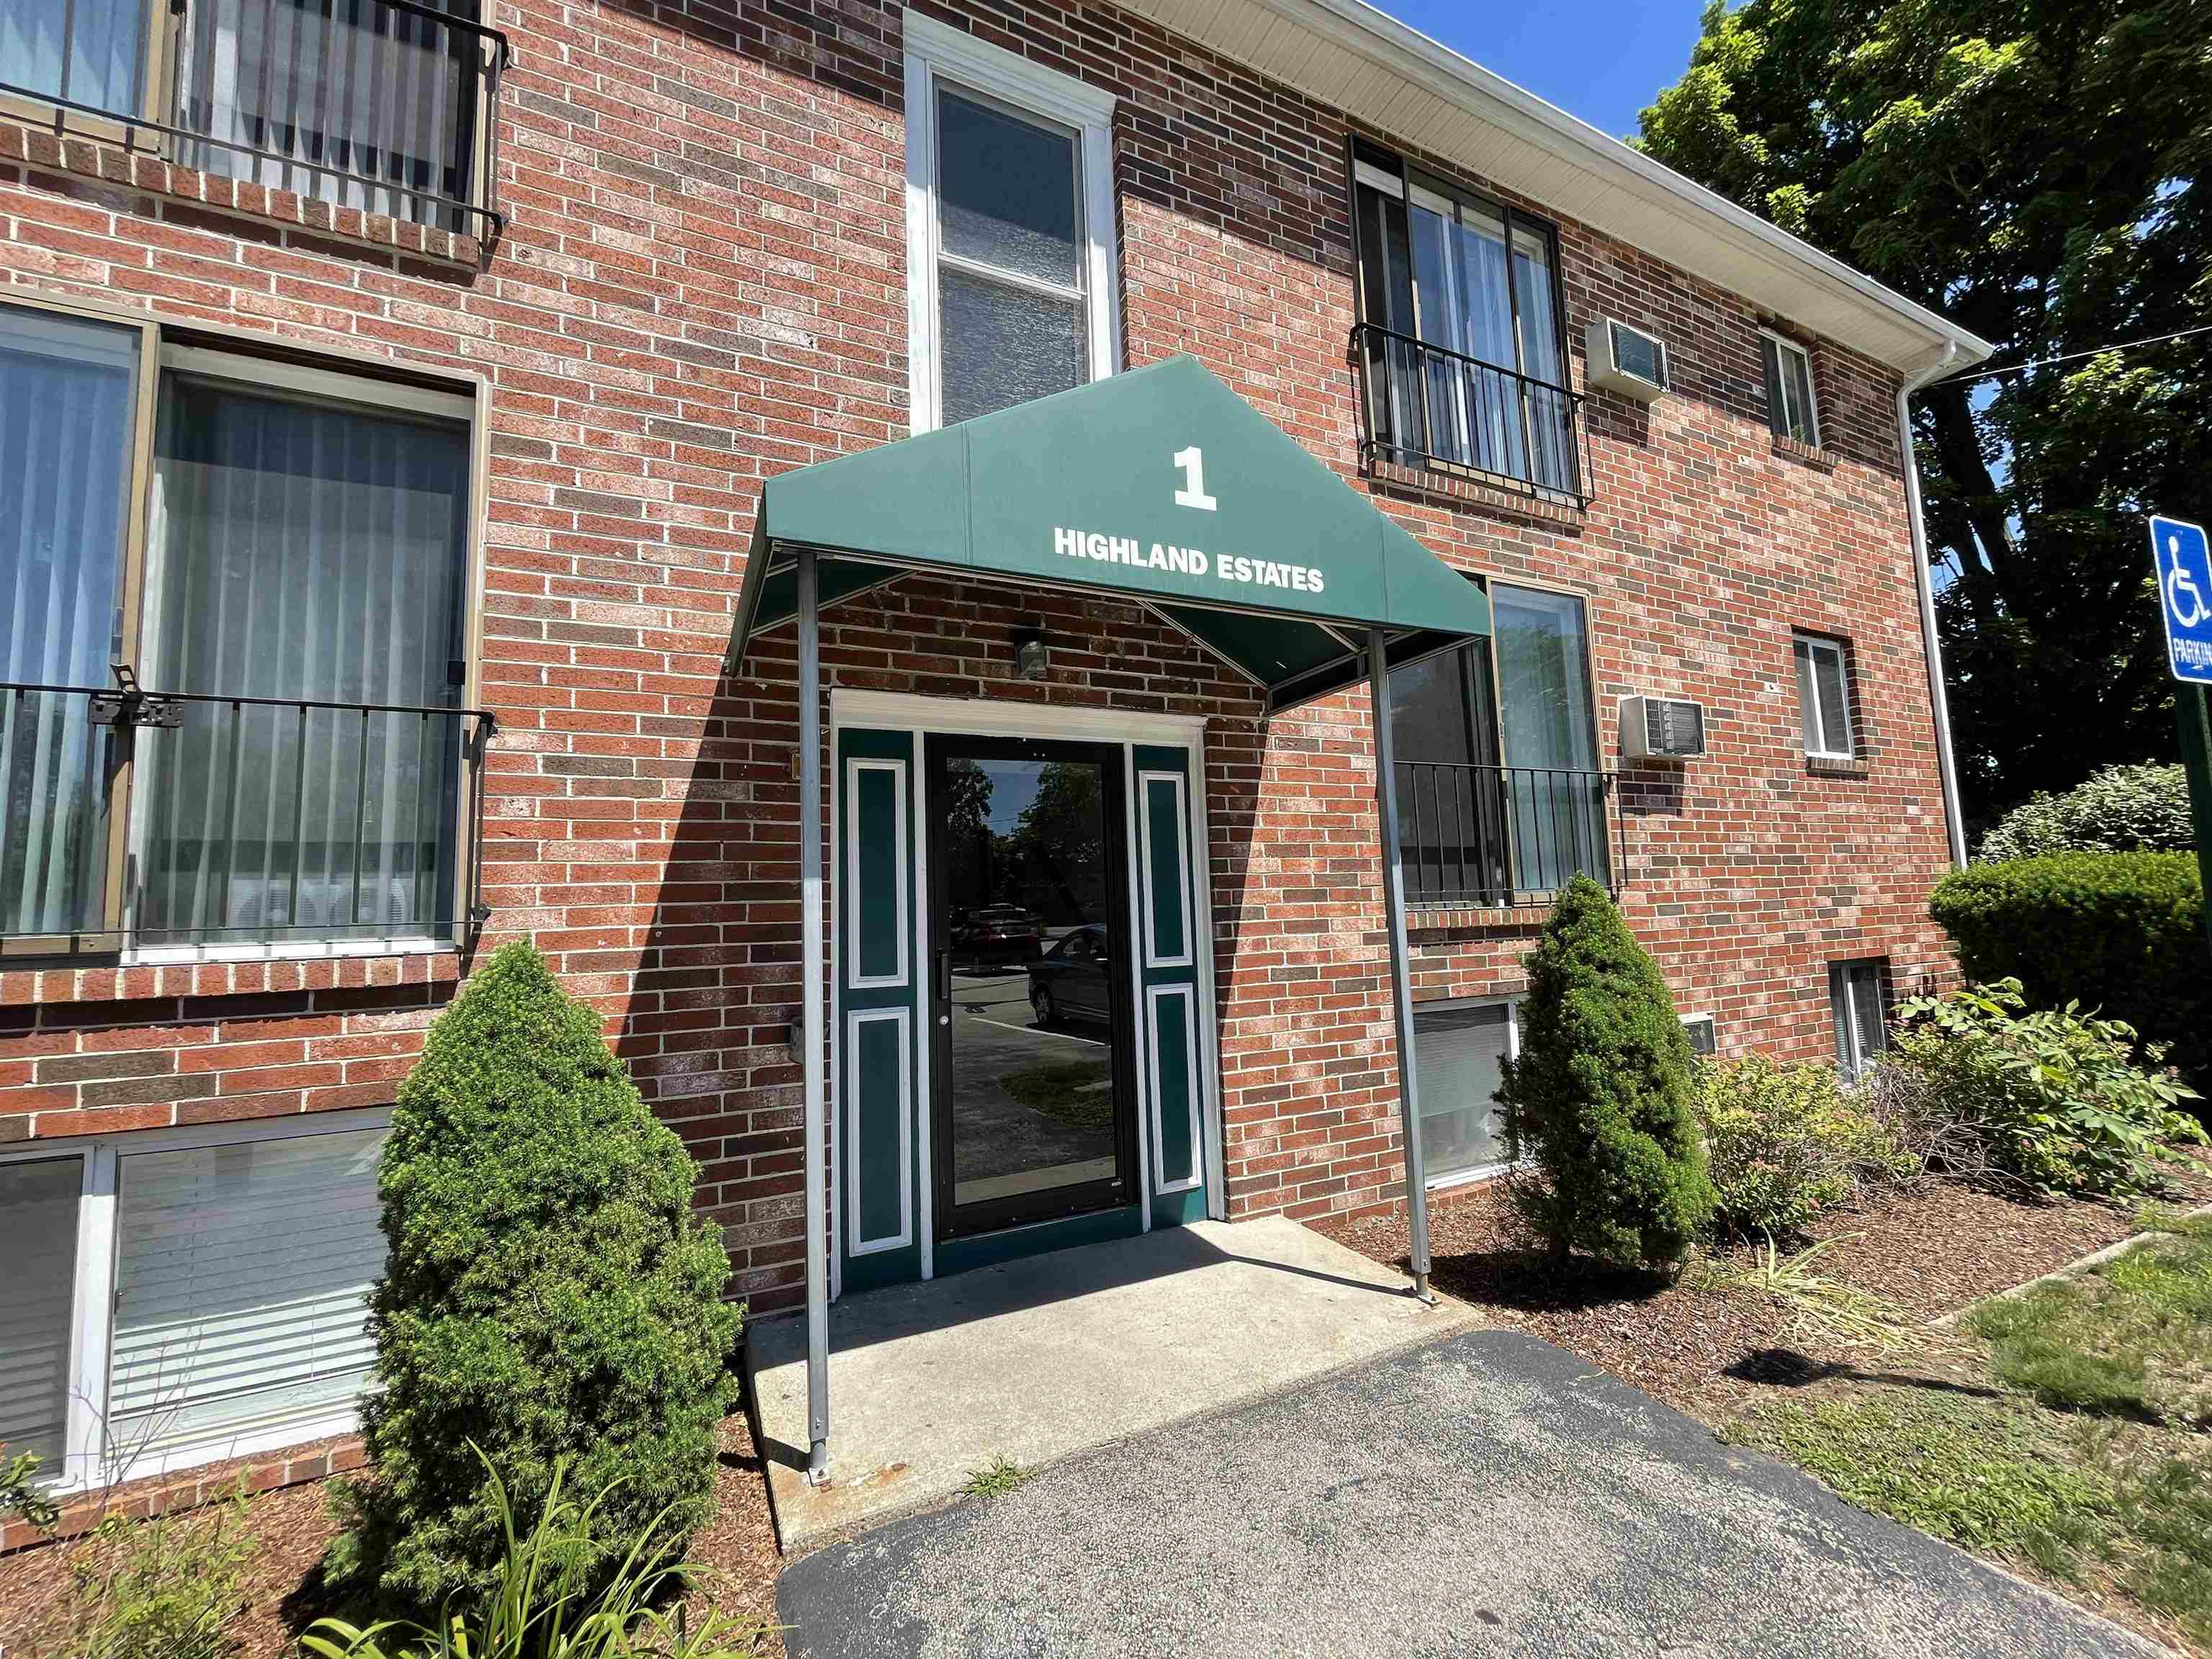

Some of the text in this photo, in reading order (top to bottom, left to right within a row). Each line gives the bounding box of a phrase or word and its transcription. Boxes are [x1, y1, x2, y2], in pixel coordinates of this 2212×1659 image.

[1174, 446, 1217, 512] 1
[1053, 527, 1325, 593] HIGHLAND ESTATES
[2172, 637, 2212, 666] PARKIN
